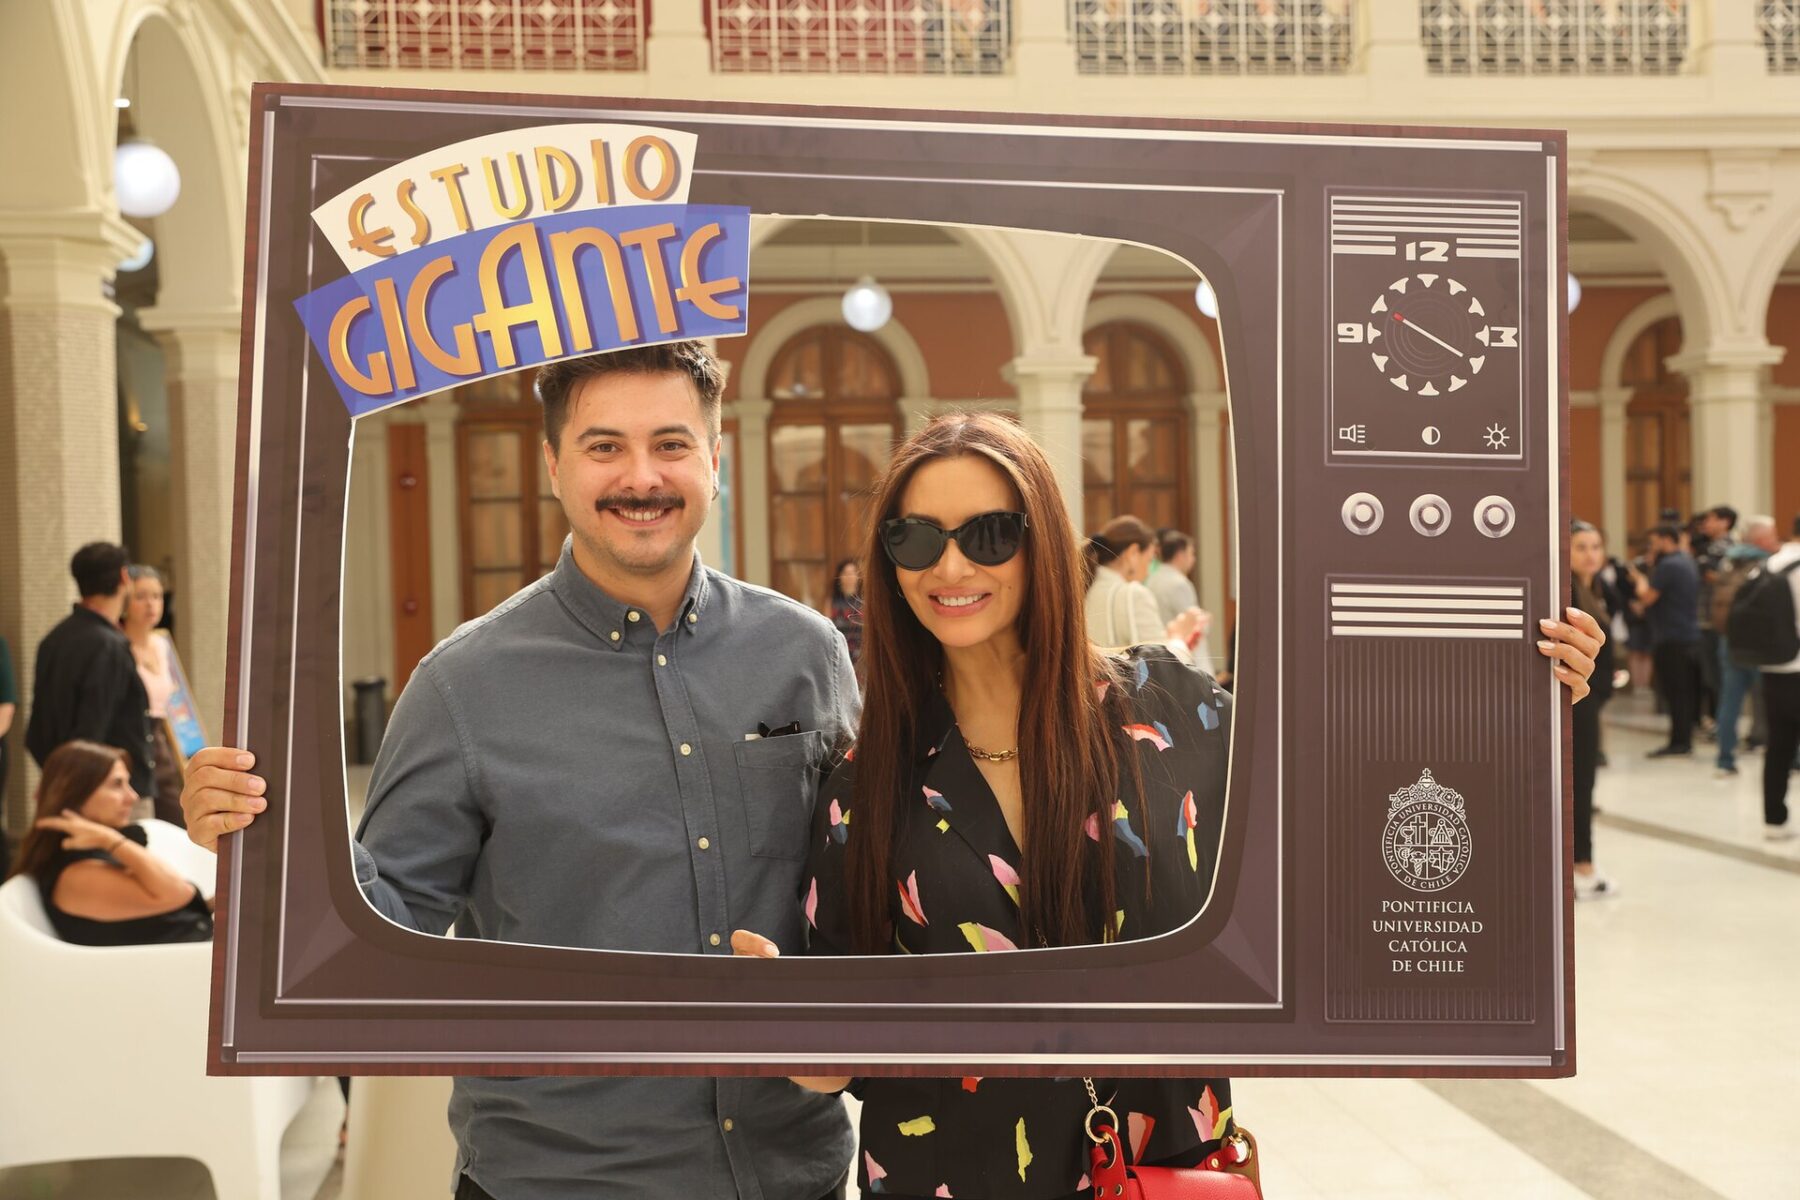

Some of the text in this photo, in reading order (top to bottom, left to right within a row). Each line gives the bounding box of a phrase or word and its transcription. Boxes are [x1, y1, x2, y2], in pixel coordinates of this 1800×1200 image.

[348, 135, 681, 258] ESTUDIO
[1405, 241, 1450, 262] 12
[328, 222, 742, 396] GIGANTE
[1337, 322, 1364, 343] 9
[1490, 326, 1518, 348] 3
[1398, 802, 1460, 826] UNIVERSIDAD
[1385, 820, 1402, 875] PONTIFICIA
[1403, 875, 1416, 887] DE
[1420, 876, 1452, 889] CHILE
[1381, 900, 1474, 913] PONTIFICIA
[1372, 920, 1483, 934] UNIVERSIDAD
[1388, 938, 1468, 953] CATÓLICA
[1392, 960, 1464, 973] DE CHILE
